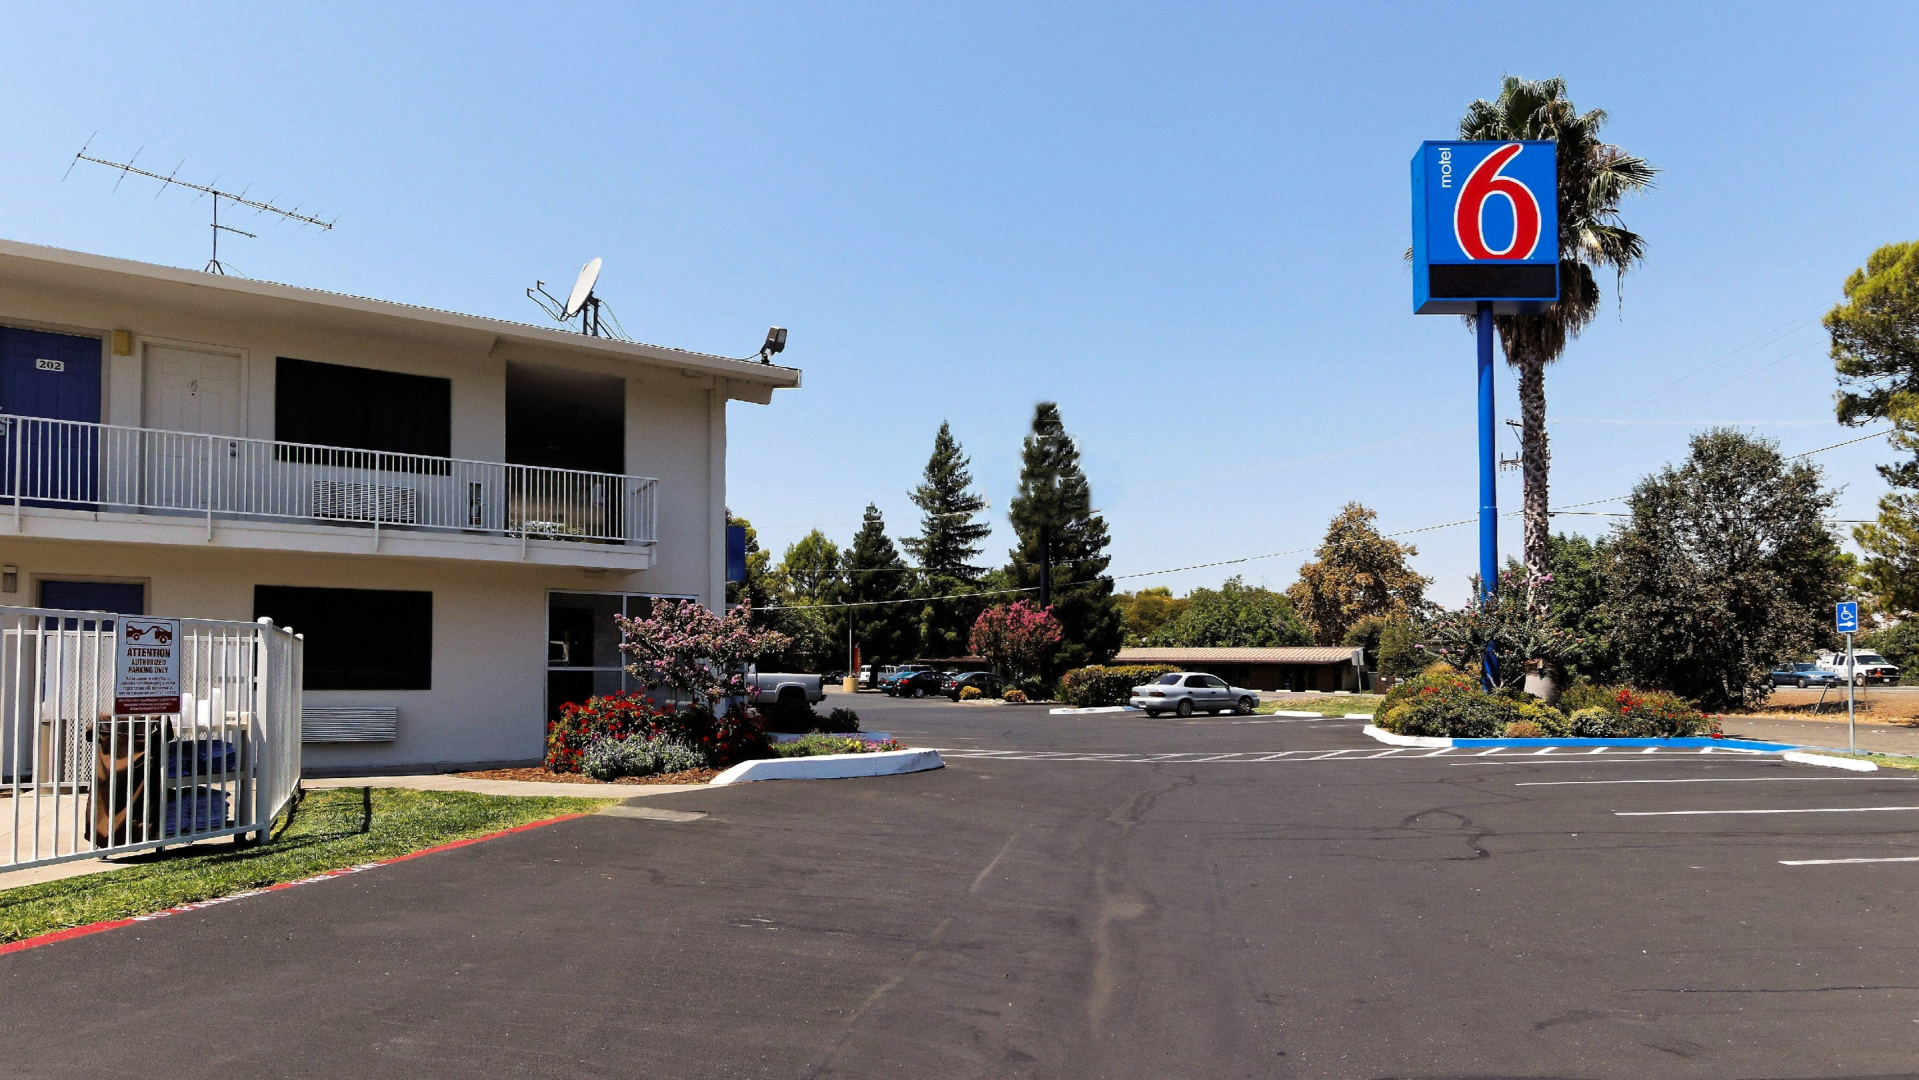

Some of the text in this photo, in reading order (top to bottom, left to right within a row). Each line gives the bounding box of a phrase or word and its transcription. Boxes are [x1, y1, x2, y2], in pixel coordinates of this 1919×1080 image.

[1438, 147, 1452, 188] motel
[1453, 143, 1542, 261] 6
[39, 360, 61, 370] 202
[127, 648, 170, 657] ATTENTION
